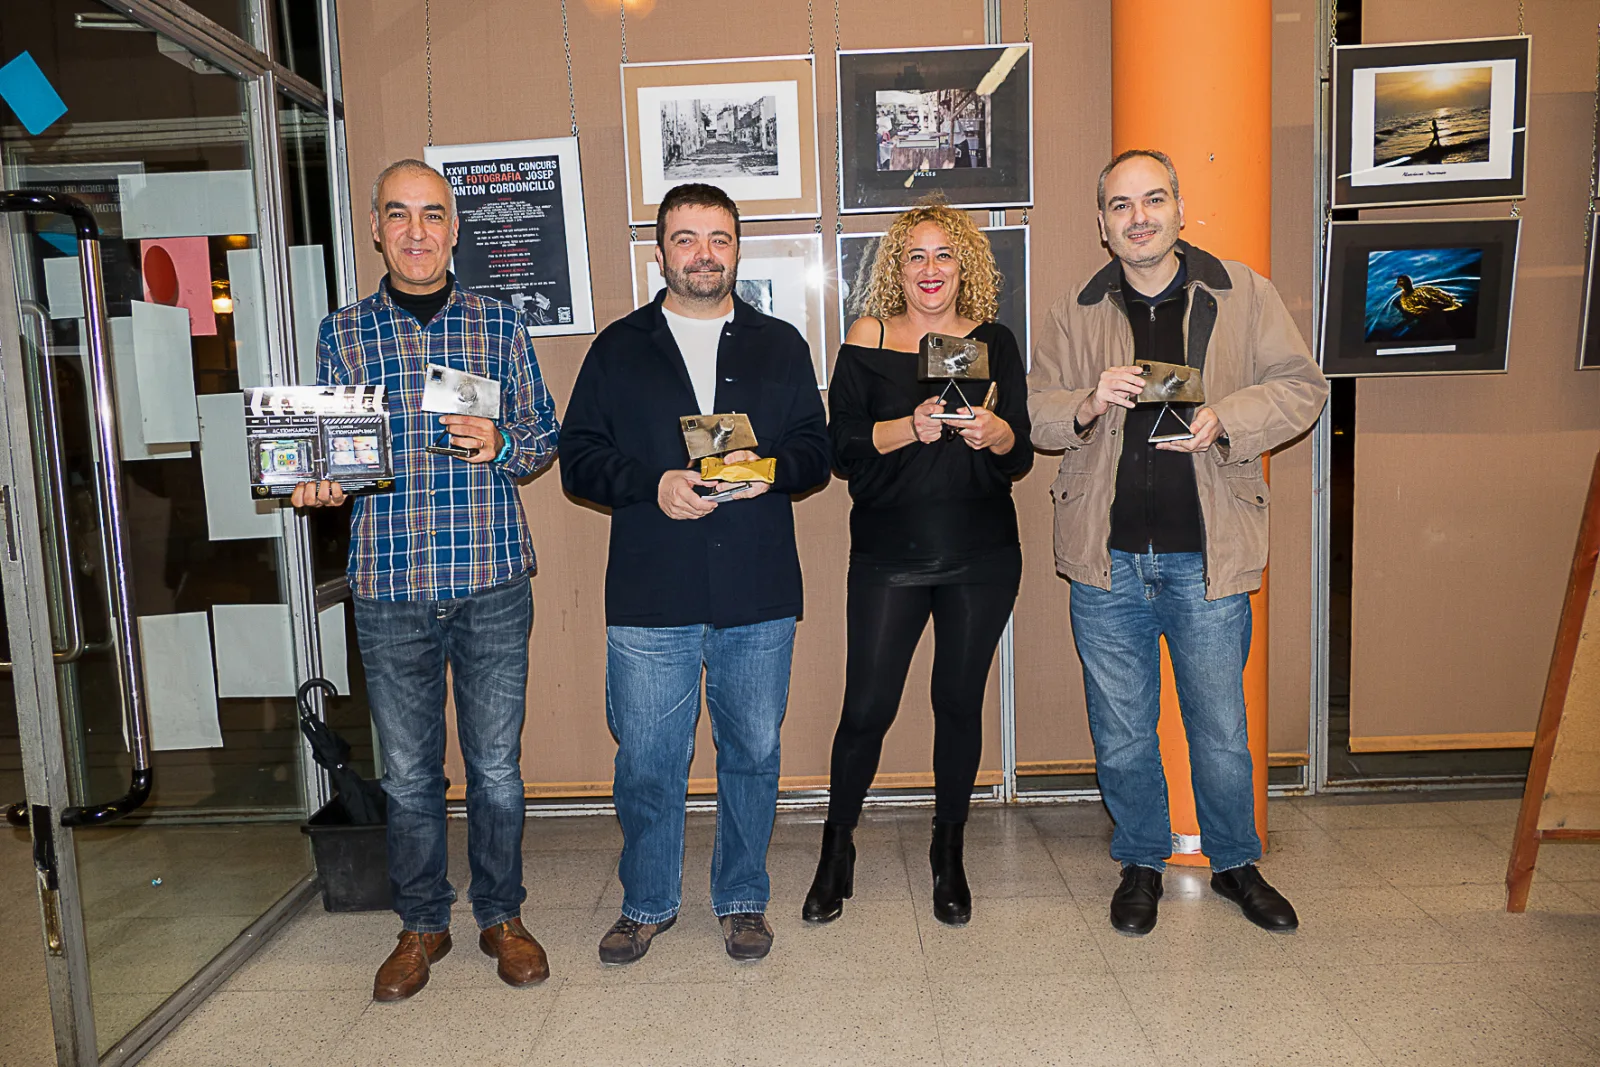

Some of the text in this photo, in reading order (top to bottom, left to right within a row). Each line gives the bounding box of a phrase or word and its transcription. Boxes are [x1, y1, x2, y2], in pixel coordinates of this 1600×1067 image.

[446, 160, 557, 176] XXVII EDICIÓ DEL CONCURS
[451, 170, 554, 186] DE FOTOGRAFIA JOSEP
[452, 180, 555, 196] ANTON CORDONCILLO
